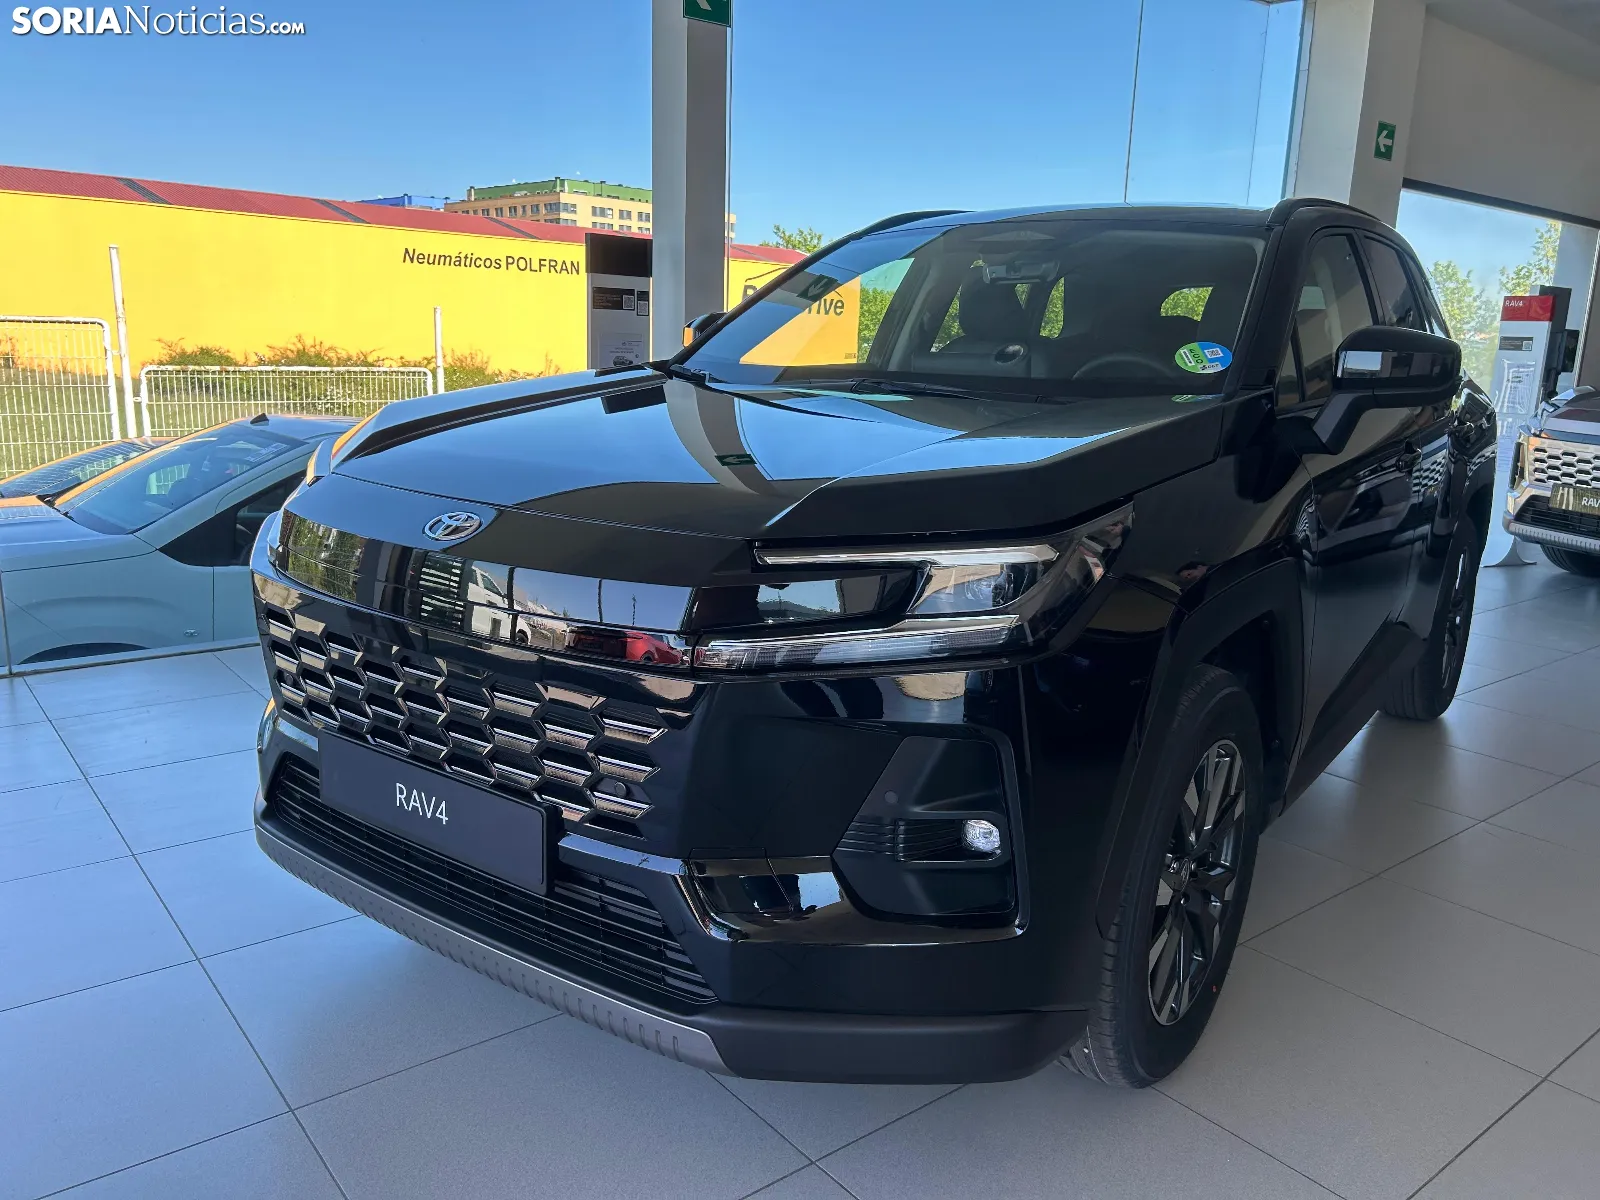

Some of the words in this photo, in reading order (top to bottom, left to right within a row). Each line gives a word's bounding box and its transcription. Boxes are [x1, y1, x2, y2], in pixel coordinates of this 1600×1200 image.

[402, 247, 502, 270] Neumáticos
[505, 255, 580, 276] POLFRAN
[1505, 299, 1524, 308] RAV4
[395, 782, 449, 825] RAV4
